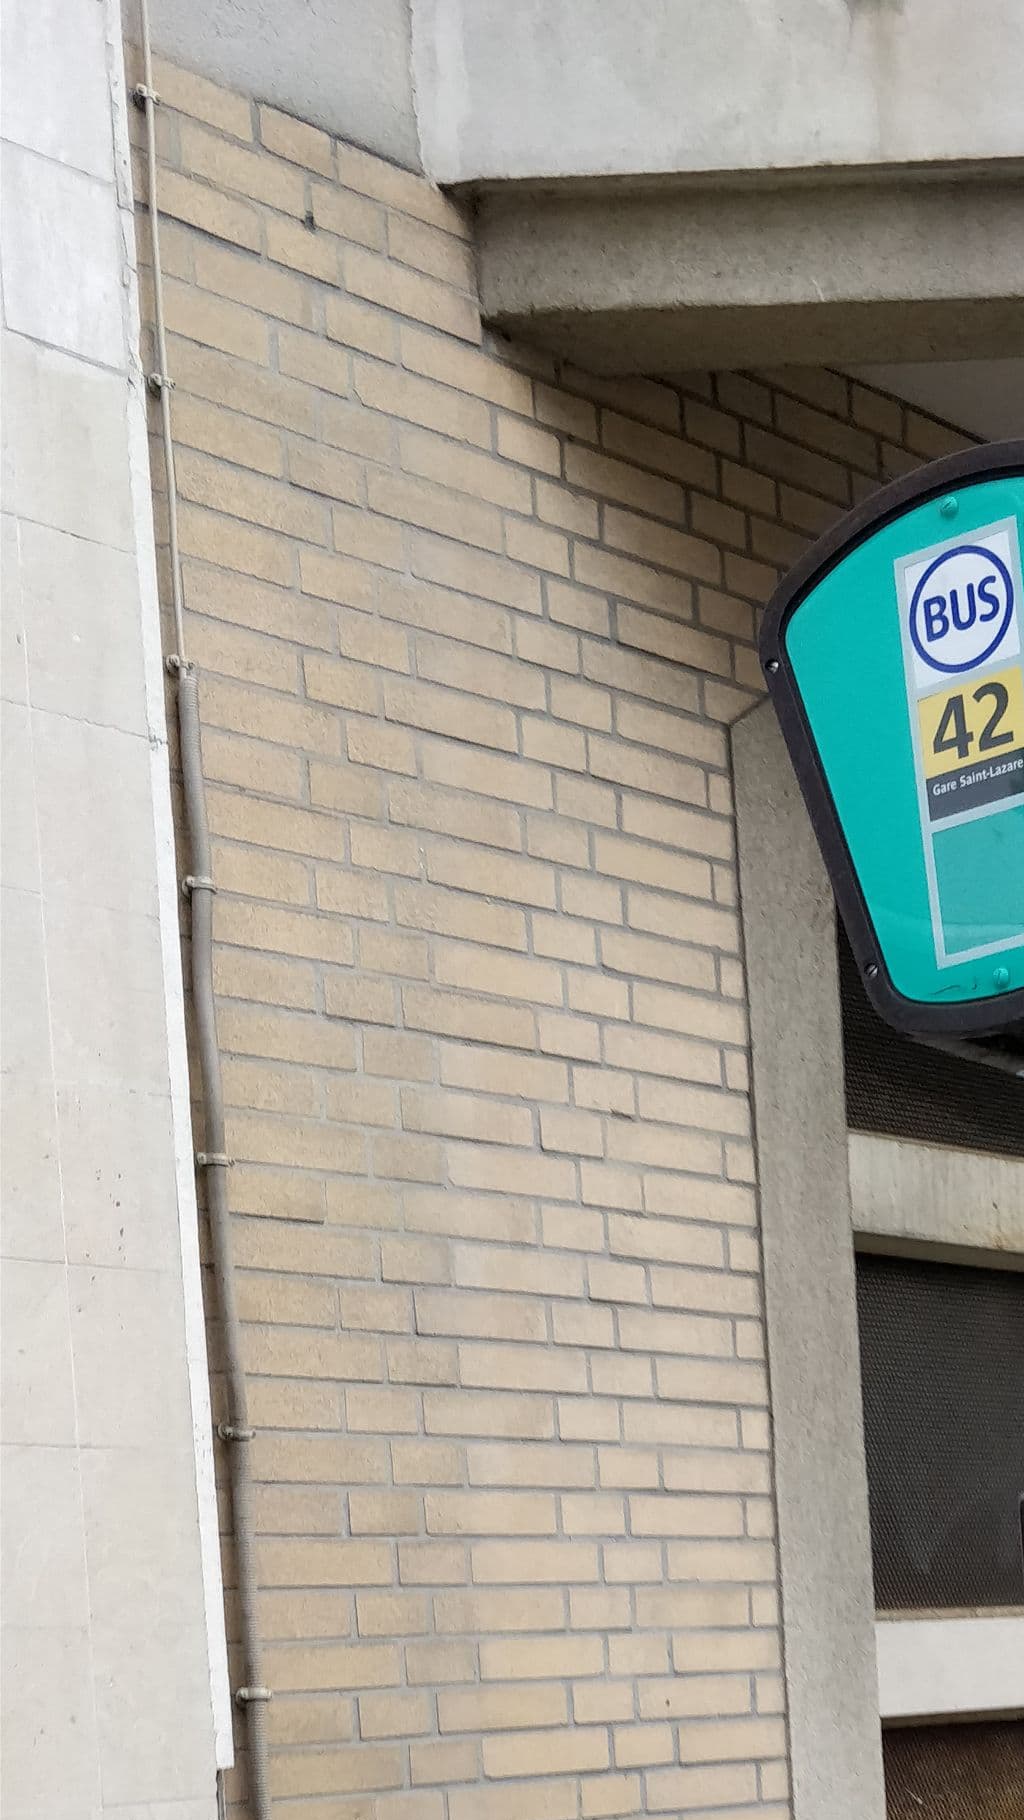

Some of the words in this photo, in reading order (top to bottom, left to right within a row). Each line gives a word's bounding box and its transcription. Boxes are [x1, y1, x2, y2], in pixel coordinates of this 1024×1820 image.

[923, 575, 1001, 643] BUS
[933, 682, 1014, 759] 42
[932, 780, 958, 796] Gare
[959, 758, 1024, 788] Saint-Lazare
